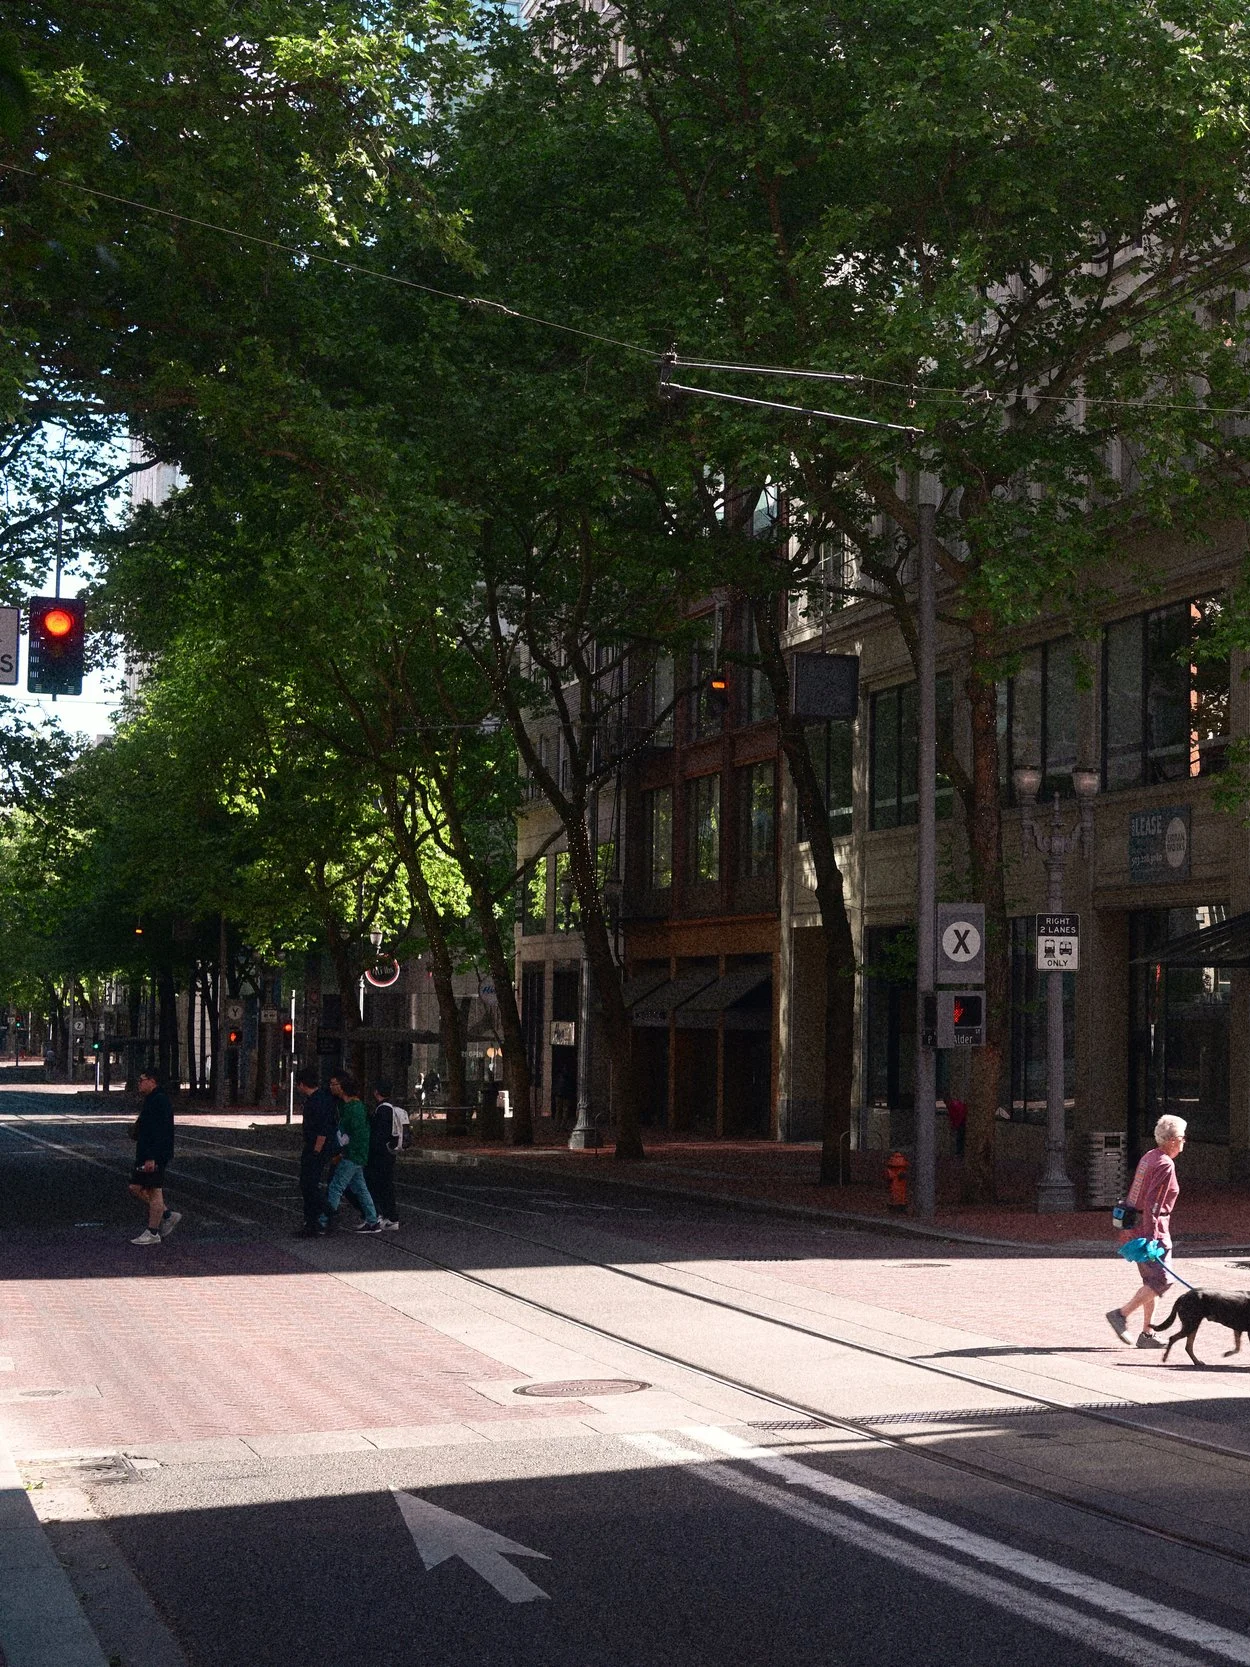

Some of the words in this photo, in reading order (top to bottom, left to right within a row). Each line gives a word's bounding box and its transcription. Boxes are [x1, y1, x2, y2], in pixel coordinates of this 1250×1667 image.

[1135, 815, 1163, 836] LEASE
[1045, 917, 1070, 925] RIGHT
[1040, 926, 1046, 934] 2
[1048, 926, 1077, 934] LANES
[952, 929, 971, 955] X
[232, 1008, 240, 1017] Y
